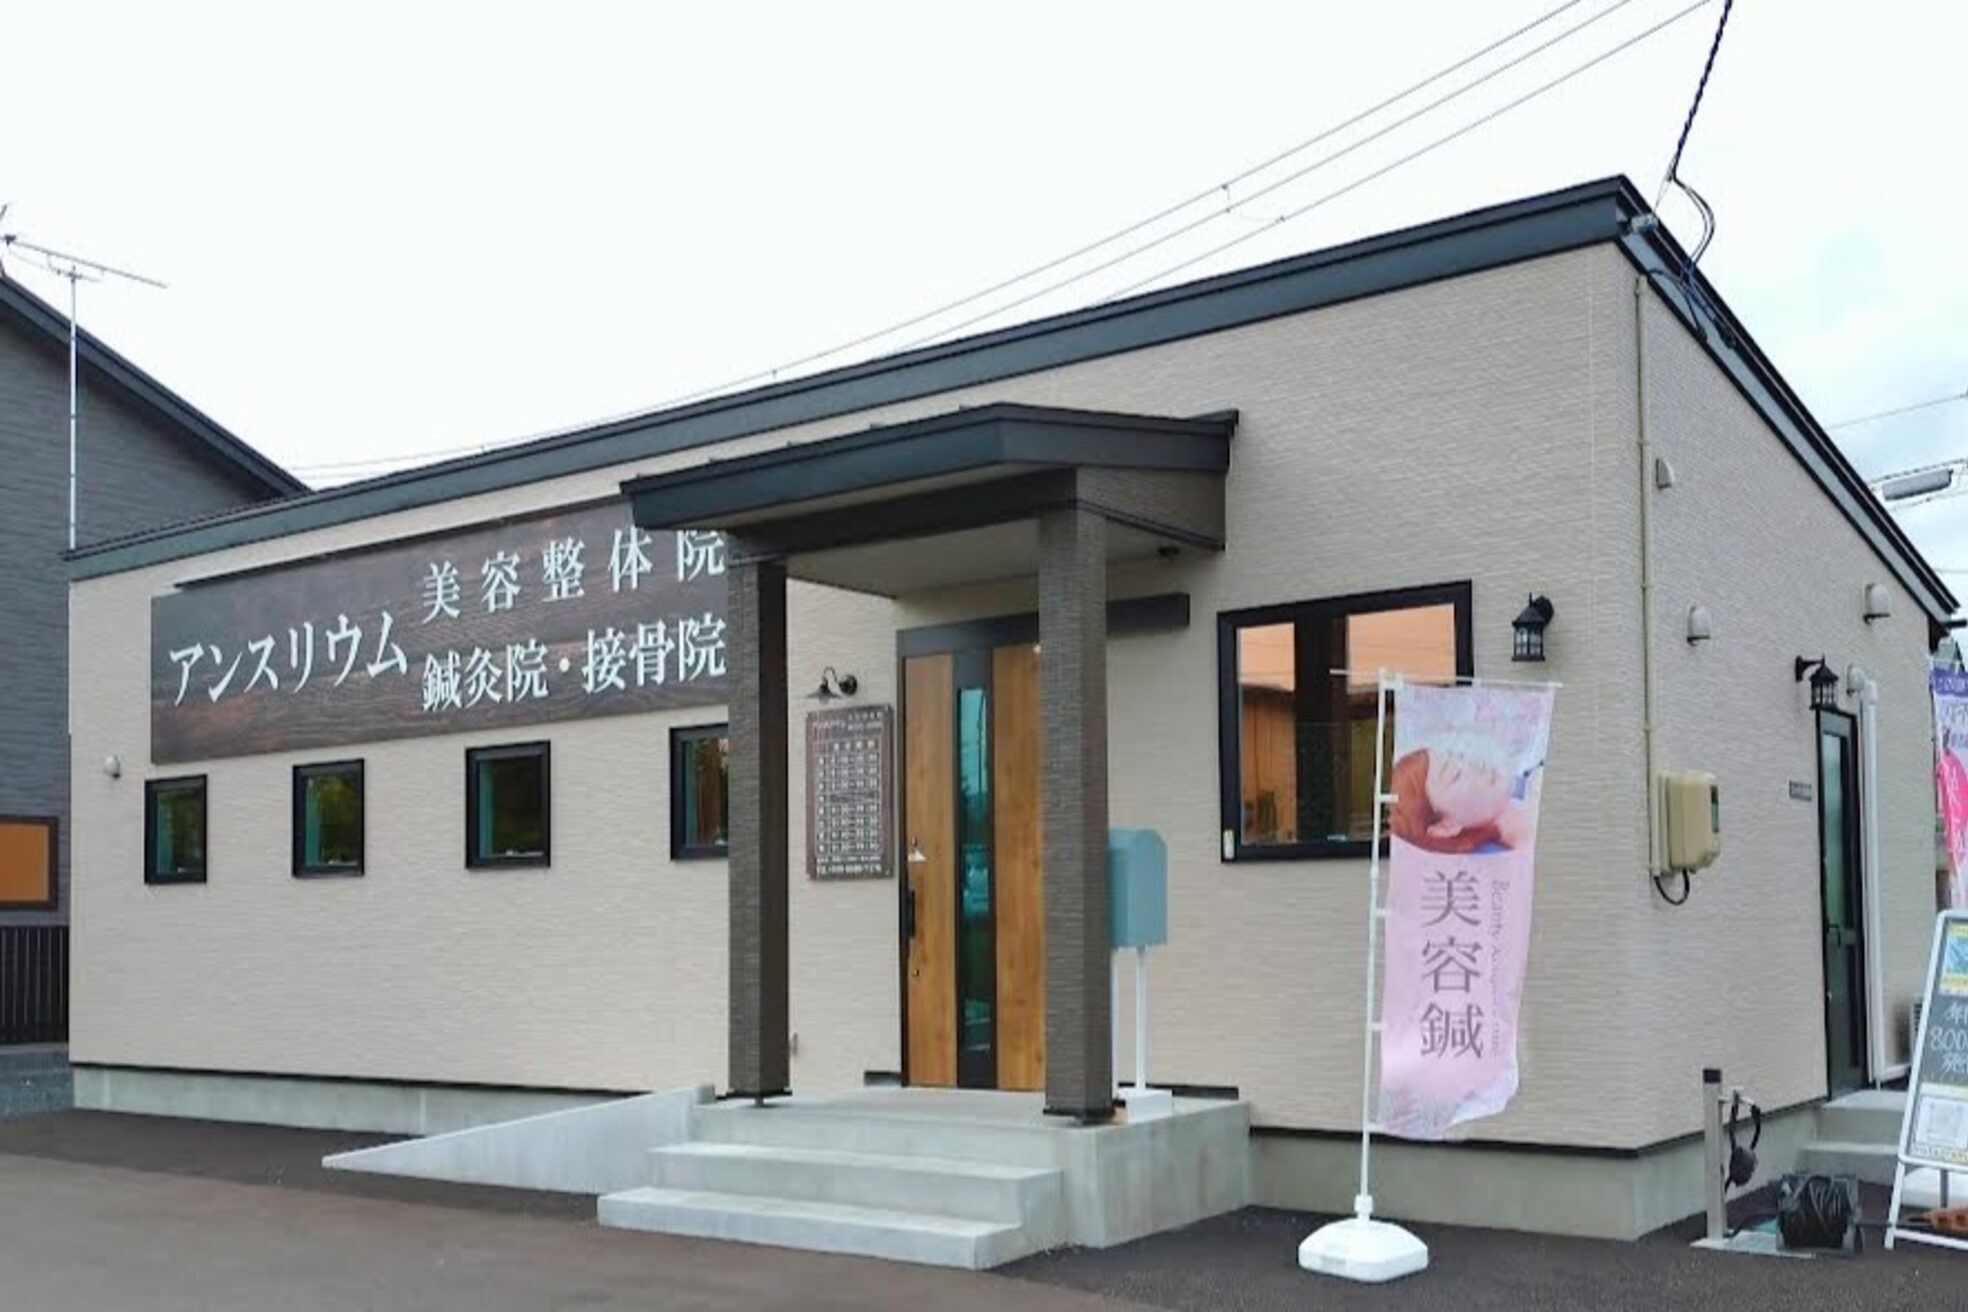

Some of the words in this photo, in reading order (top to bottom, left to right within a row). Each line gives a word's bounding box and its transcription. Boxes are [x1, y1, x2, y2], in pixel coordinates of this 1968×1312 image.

[422, 525, 726, 624] 美容整体院
[169, 611, 407, 706] アンスリウム
[423, 612, 727, 711] 鍼灸院・接骨院
[1419, 871, 1485, 1060] 美容鍼
